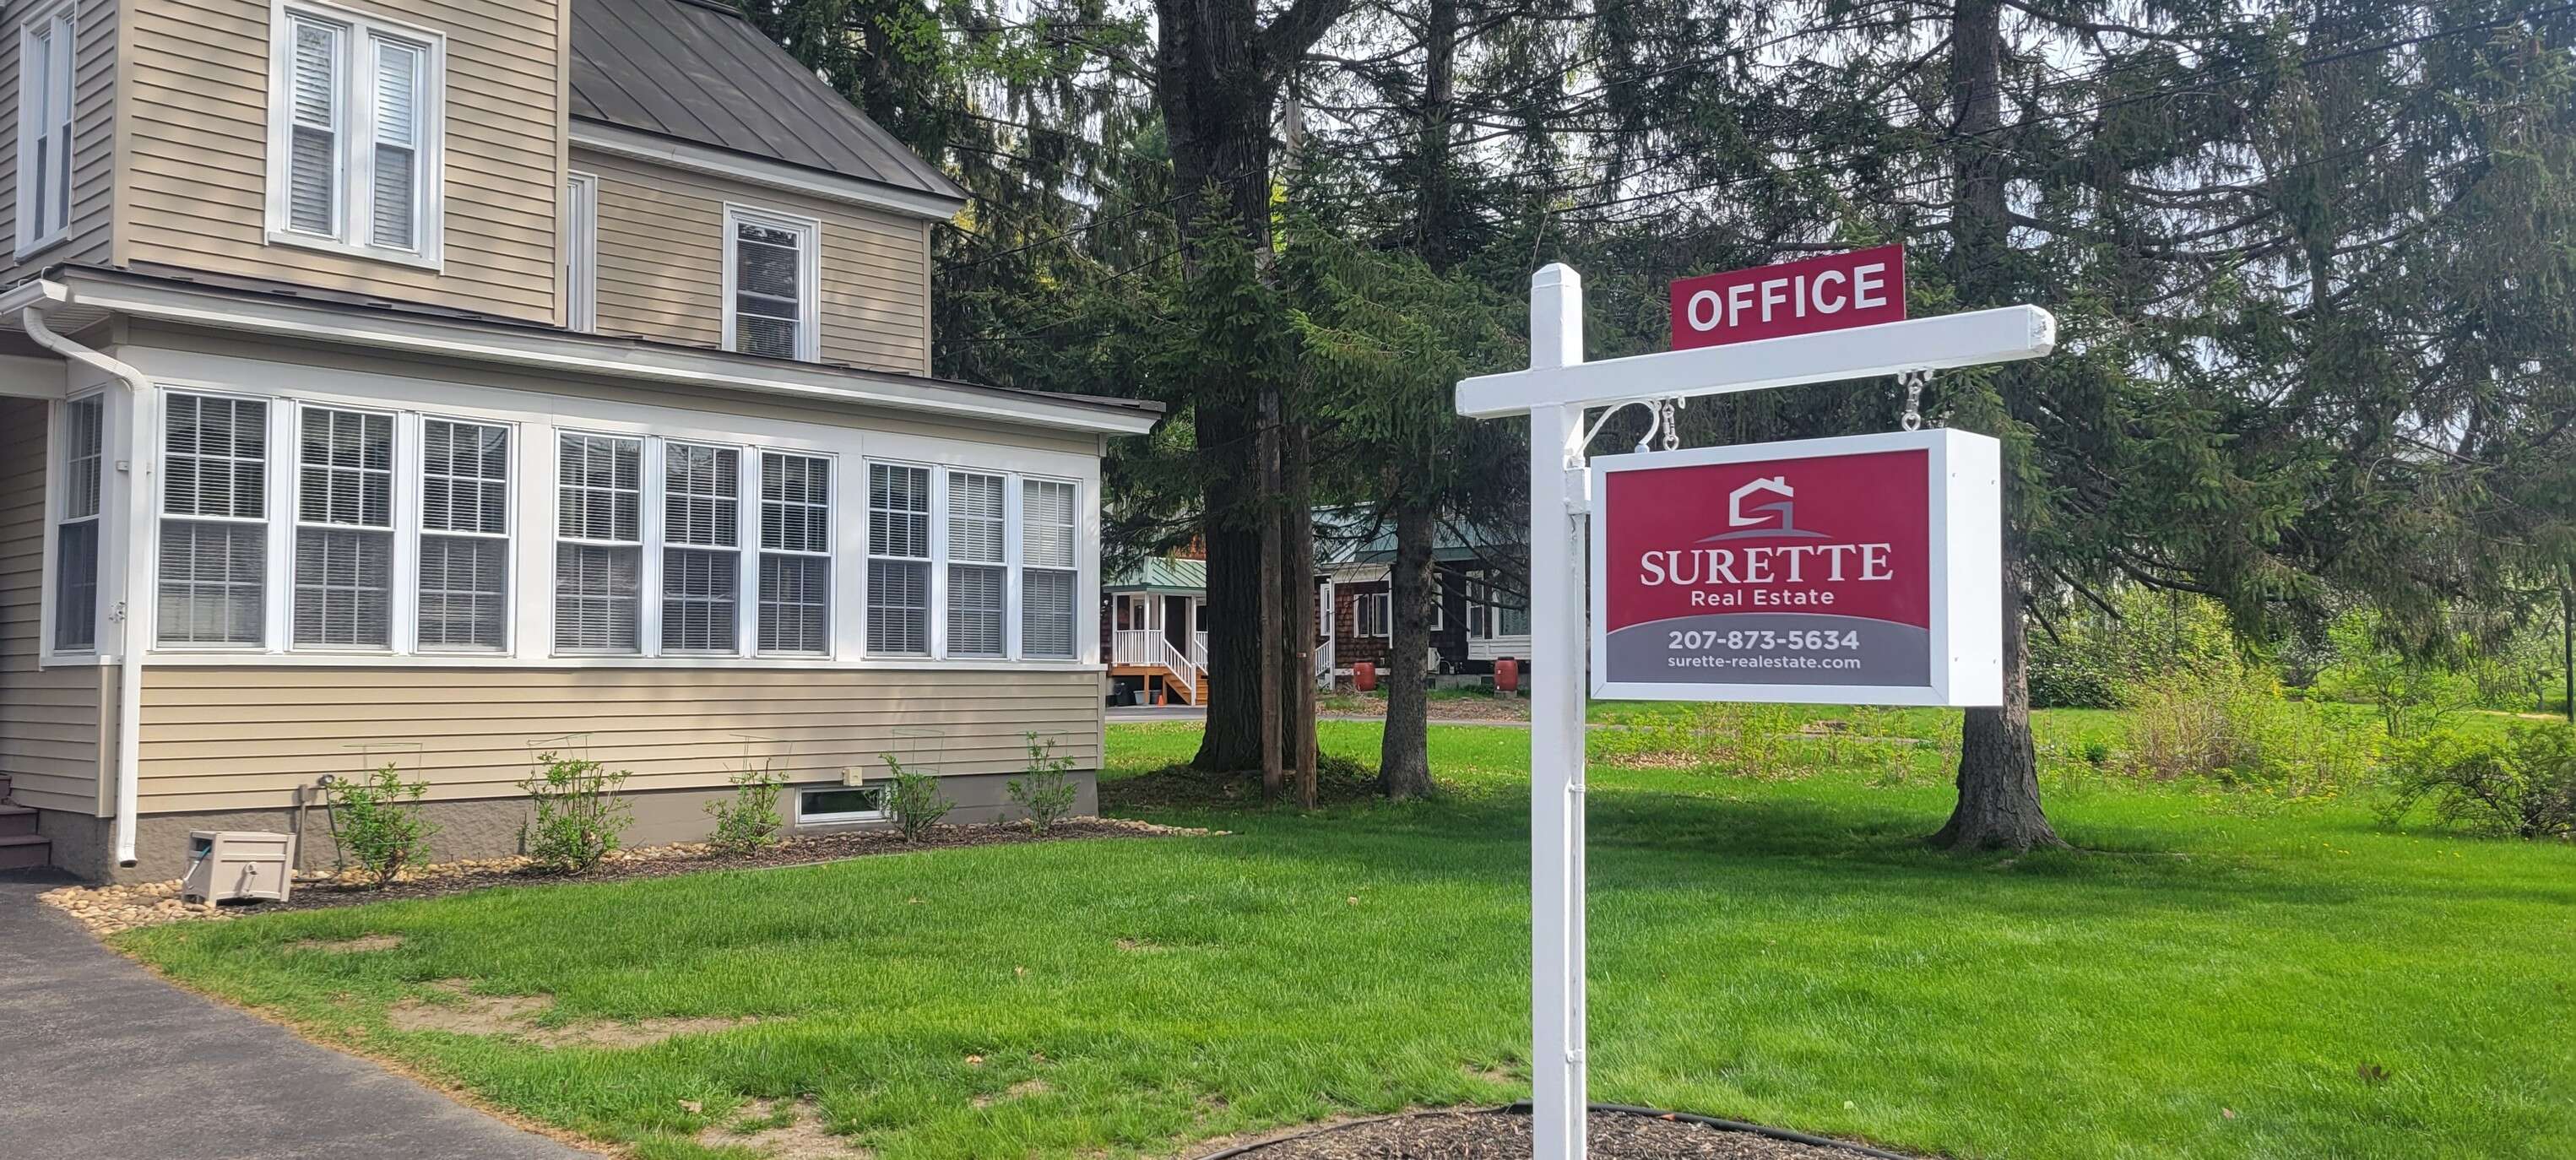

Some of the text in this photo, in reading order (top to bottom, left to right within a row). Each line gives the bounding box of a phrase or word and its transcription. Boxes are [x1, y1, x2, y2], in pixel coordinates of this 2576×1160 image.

[1688, 263, 1887, 332] OFFICE
[1640, 543, 1893, 586] SURETTE
[1690, 588, 1835, 606] Real Estate
[1668, 630, 1859, 651] 207-873-5634
[1668, 653, 1861, 669] surette-realestate.com
